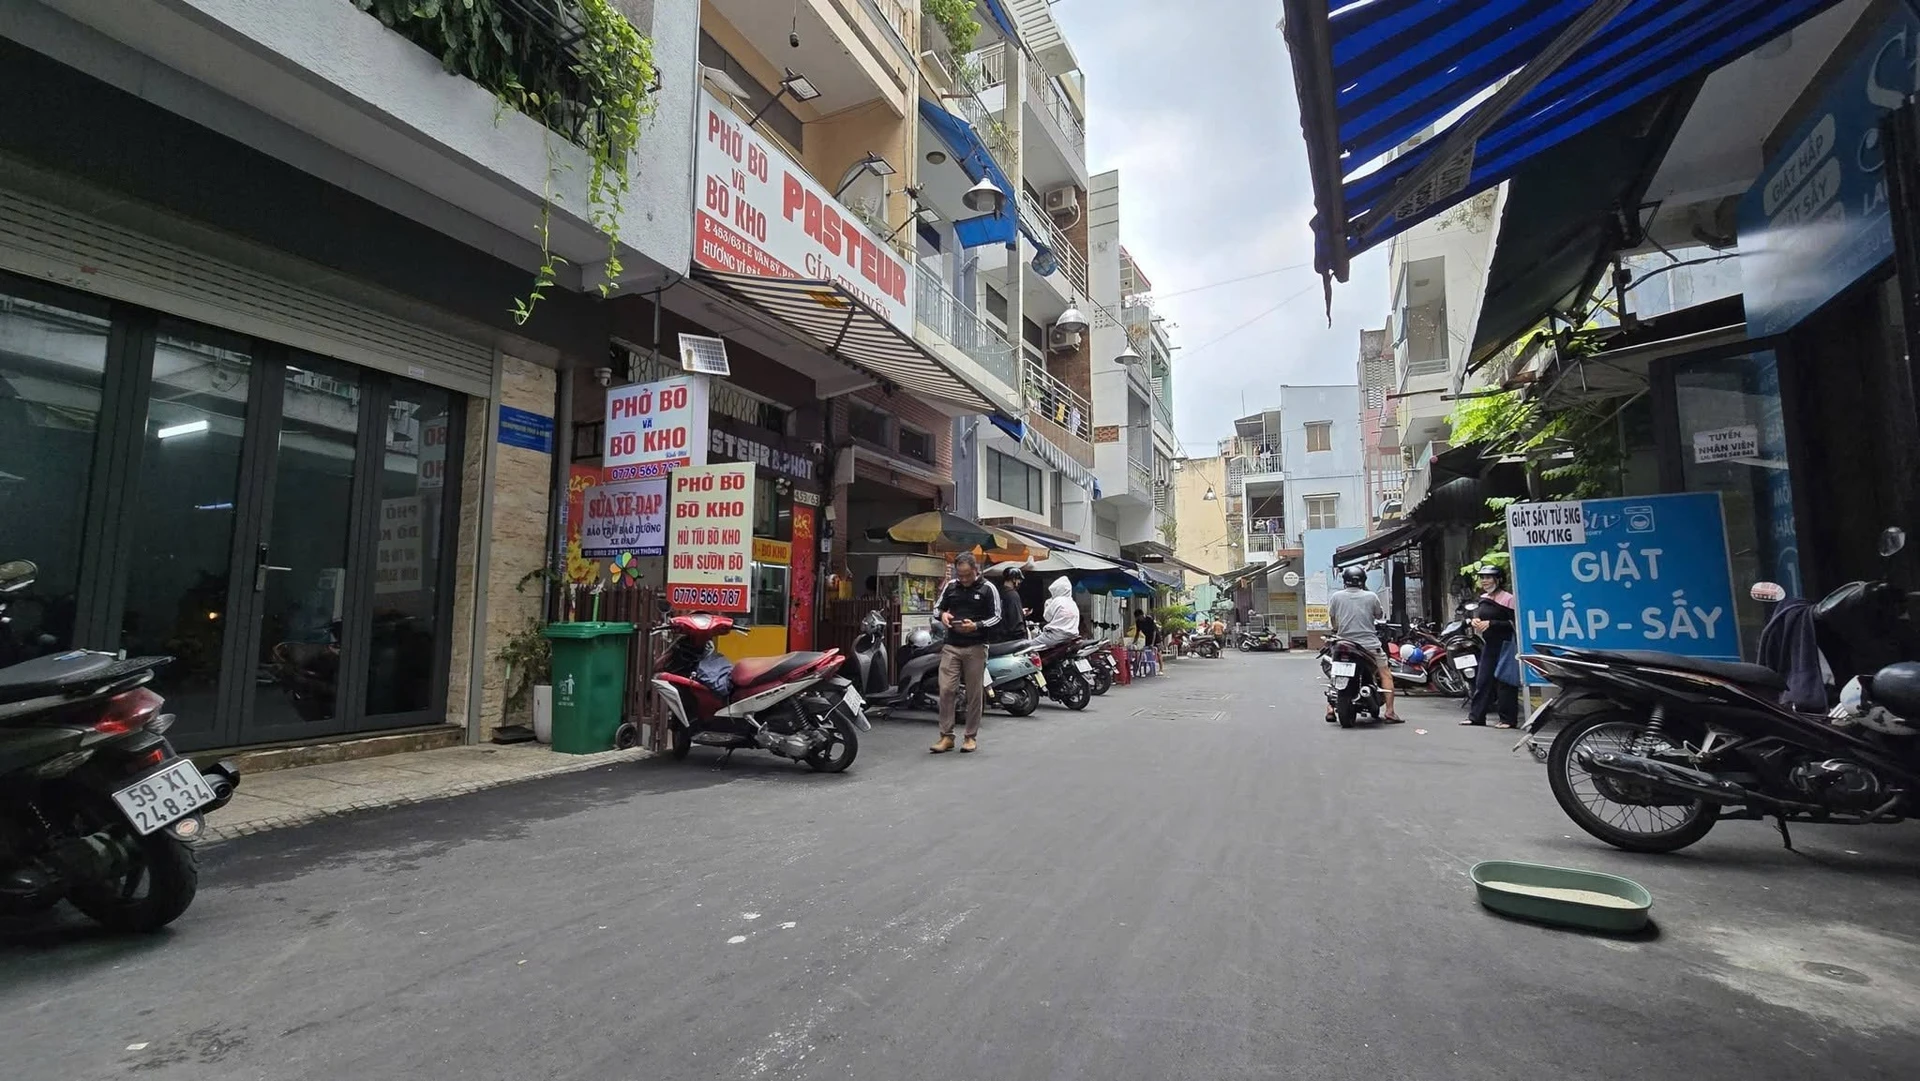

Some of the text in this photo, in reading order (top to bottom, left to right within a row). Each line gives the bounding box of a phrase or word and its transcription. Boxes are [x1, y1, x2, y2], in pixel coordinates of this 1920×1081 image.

[708, 110, 768, 184] PHỞ BÒ
[731, 168, 746, 195] VÀ
[706, 174, 767, 243] BÒ KHO
[782, 170, 907, 307] PASTEUR
[703, 239, 735, 270] HƯƠNG
[611, 384, 687, 420] PHỞ BÒ
[642, 418, 653, 429] VÀ
[610, 427, 686, 457] BÒ KHO
[707, 428, 769, 468] STEUR
[1698, 439, 1755, 455] NHÂN VIÊN
[612, 467, 637, 480] 0779
[639, 464, 658, 477] 566
[677, 472, 745, 493] PHỞ BÒ
[676, 500, 744, 519] BÒ KHO
[1512, 504, 1581, 531] GIẶT SẤY TỪ 5KG
[707, 526, 719, 545] BÒ
[722, 529, 740, 545] KHO
[1526, 528, 1573, 545] 10K/1KG
[729, 552, 743, 571] BÒ
[1571, 542, 1663, 589] GIẶT
[673, 588, 741, 606] 0779 566 787
[1527, 592, 1610, 641] HẤP
[1641, 588, 1722, 641] SẤY
[127, 768, 189, 808] 59-X1
[135, 783, 209, 832] 248.34
